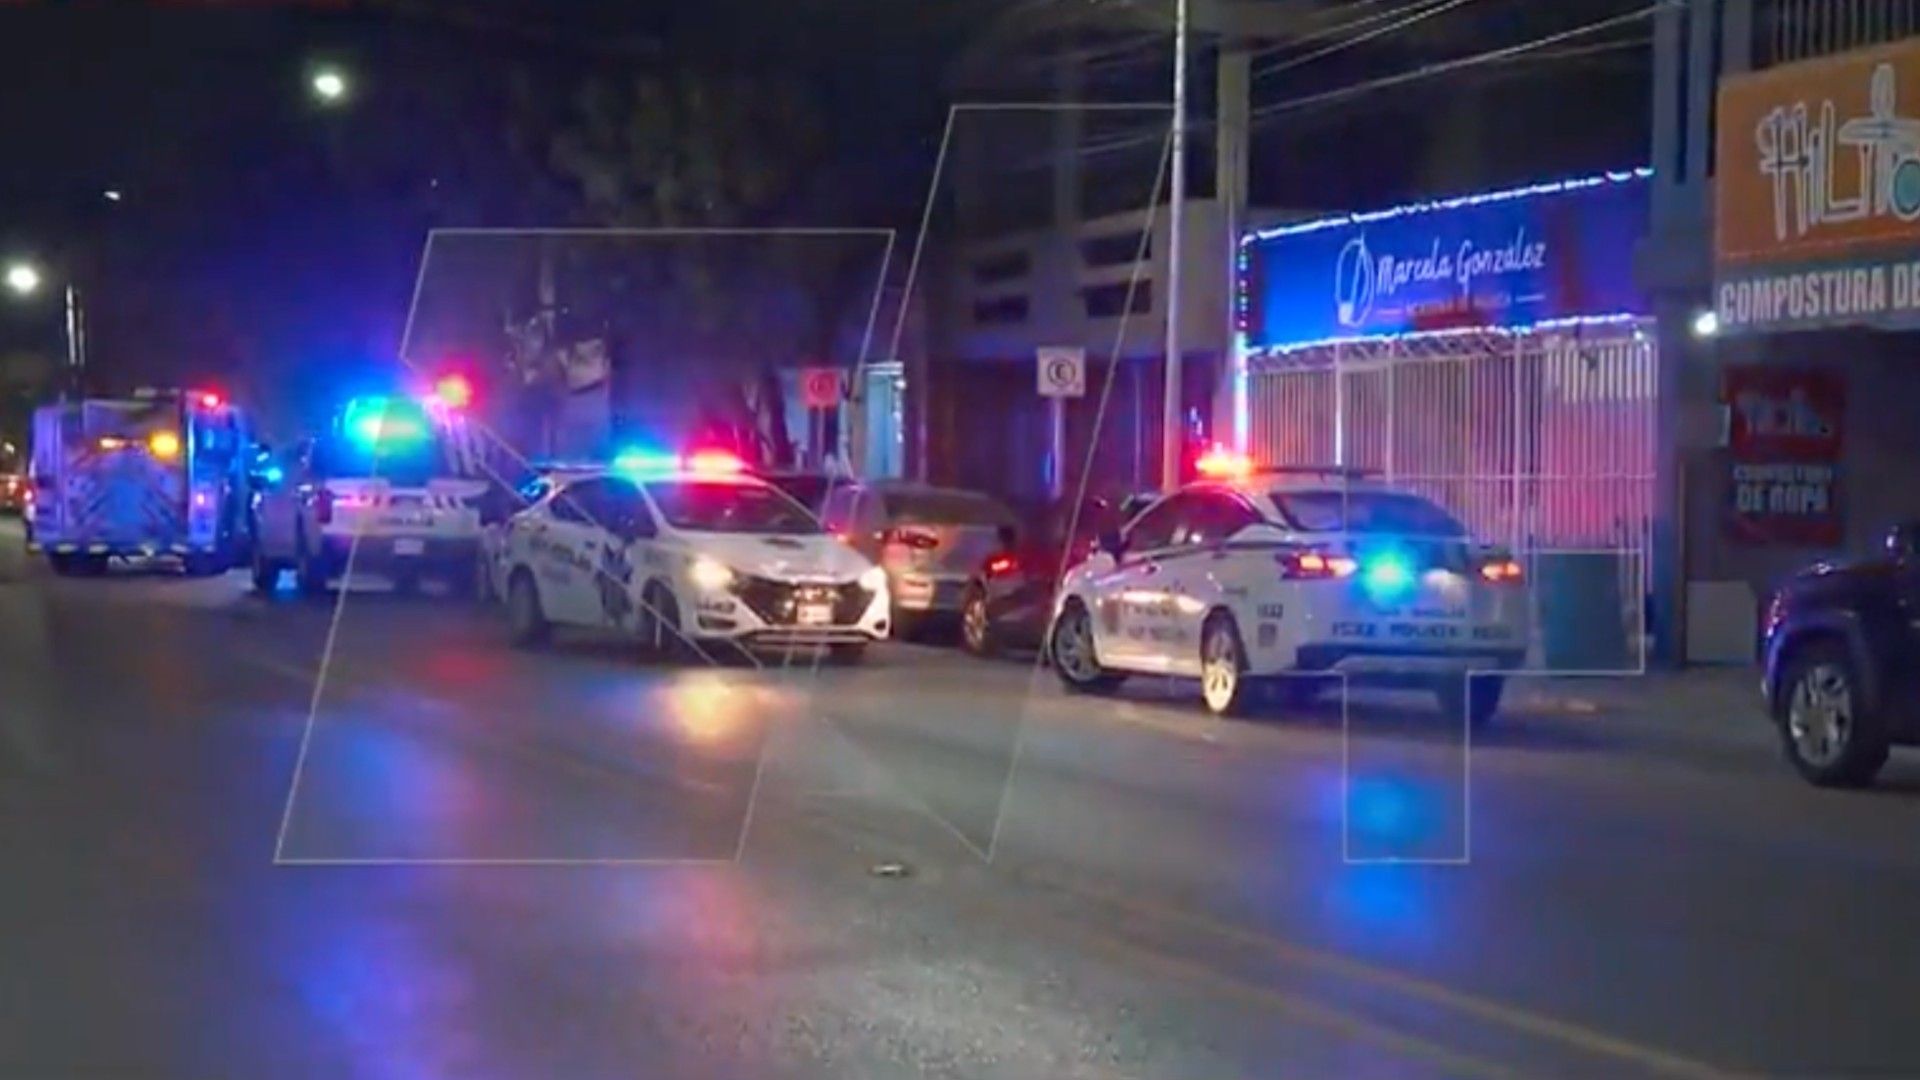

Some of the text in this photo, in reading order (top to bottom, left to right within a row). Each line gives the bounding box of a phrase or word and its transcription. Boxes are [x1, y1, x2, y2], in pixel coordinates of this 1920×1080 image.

[1376, 235, 1452, 295] Marcela
[1719, 262, 1920, 325] COMPOSTURA DE
